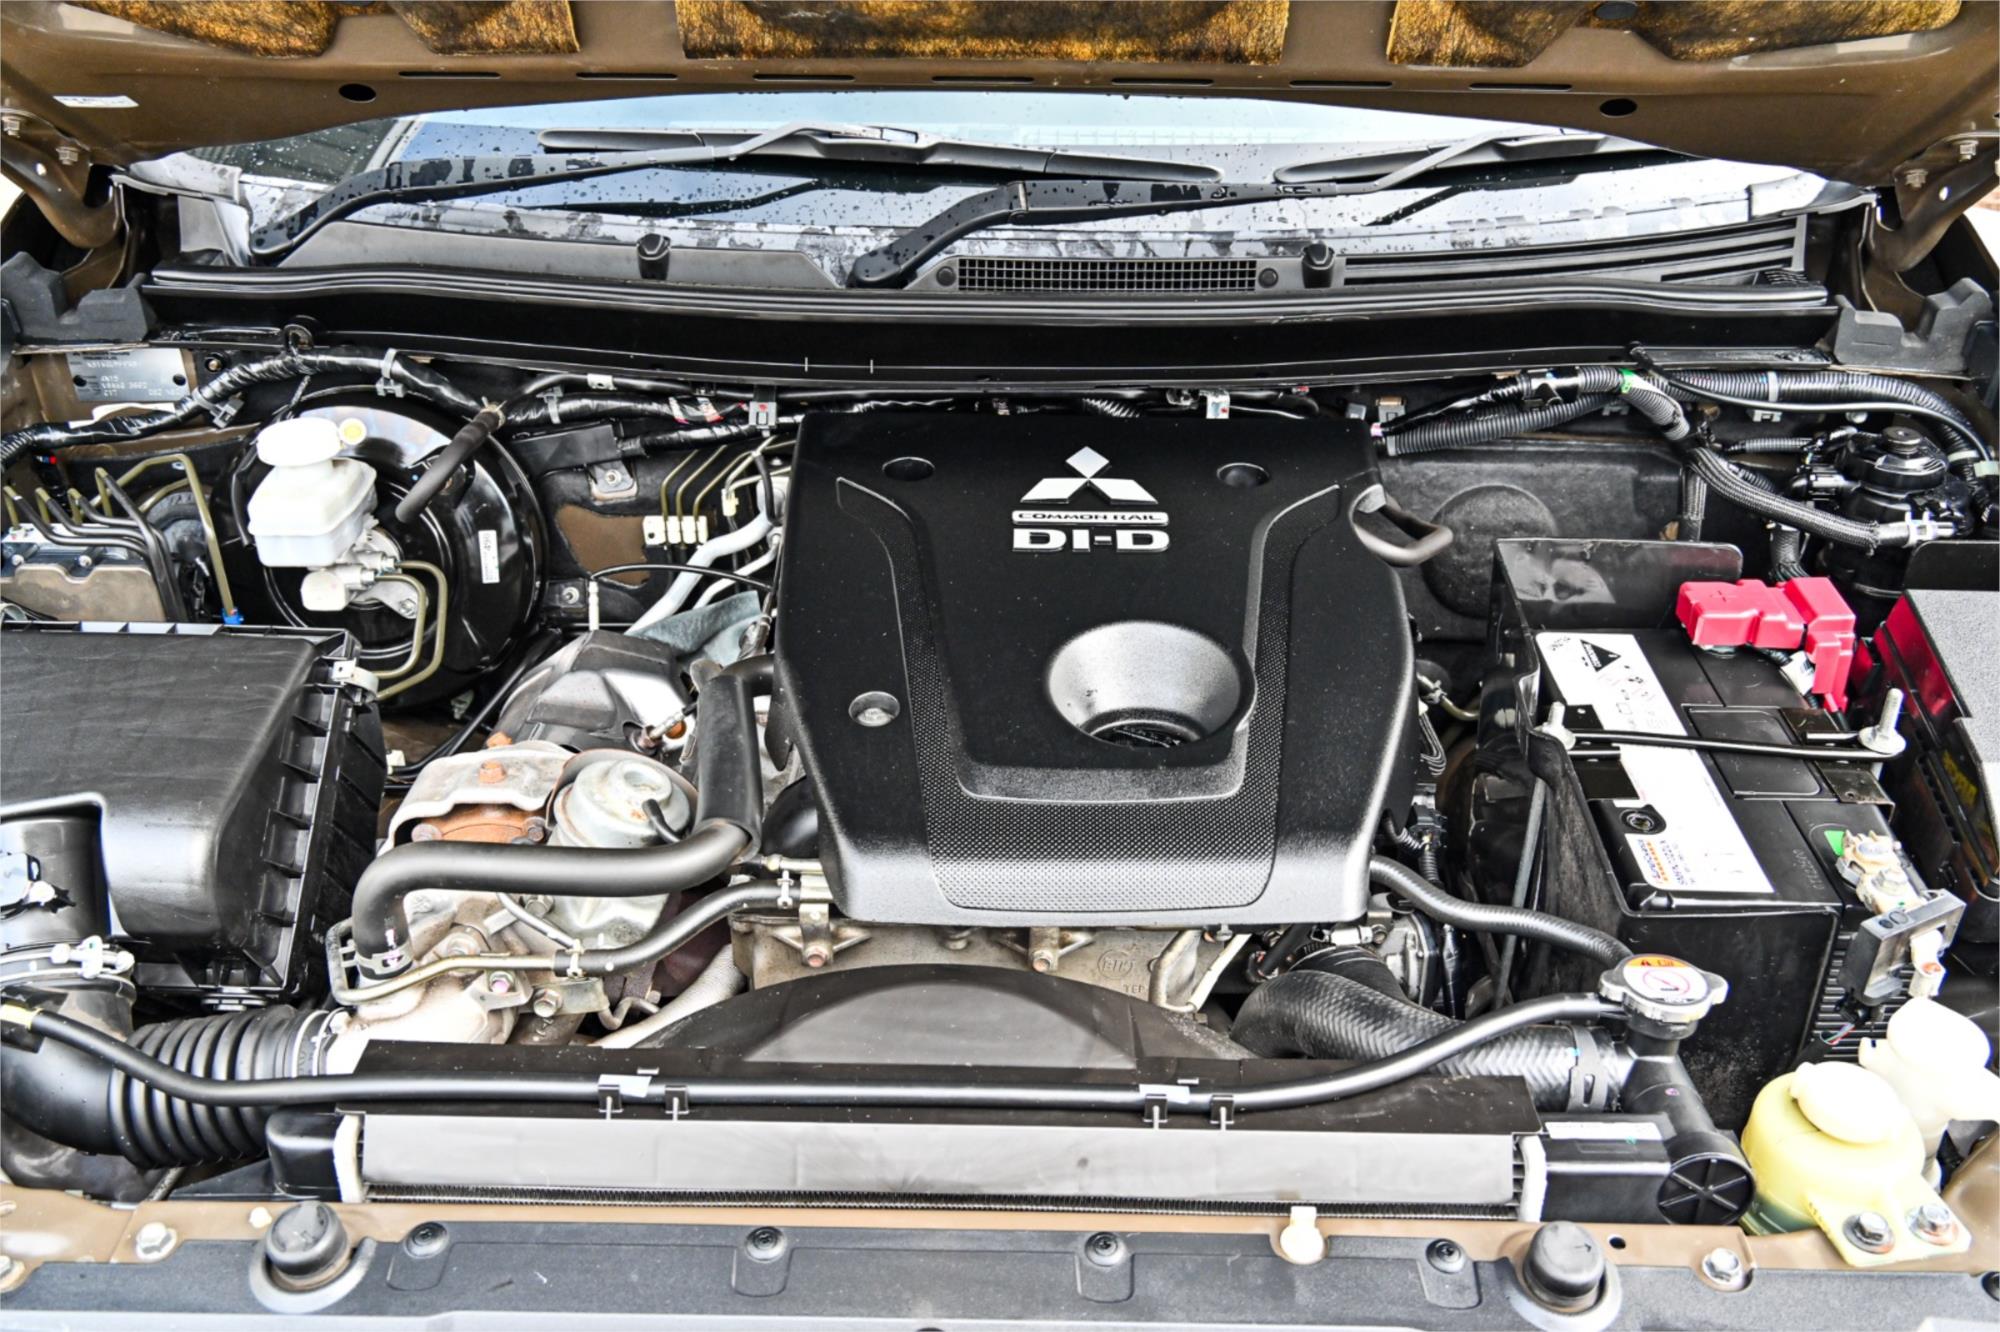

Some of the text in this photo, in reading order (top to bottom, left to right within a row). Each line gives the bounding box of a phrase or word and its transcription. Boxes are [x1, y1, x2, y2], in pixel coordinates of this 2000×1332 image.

[1018, 512, 1162, 521] COMMON RAIL
[1013, 528, 1170, 552] DI-D
